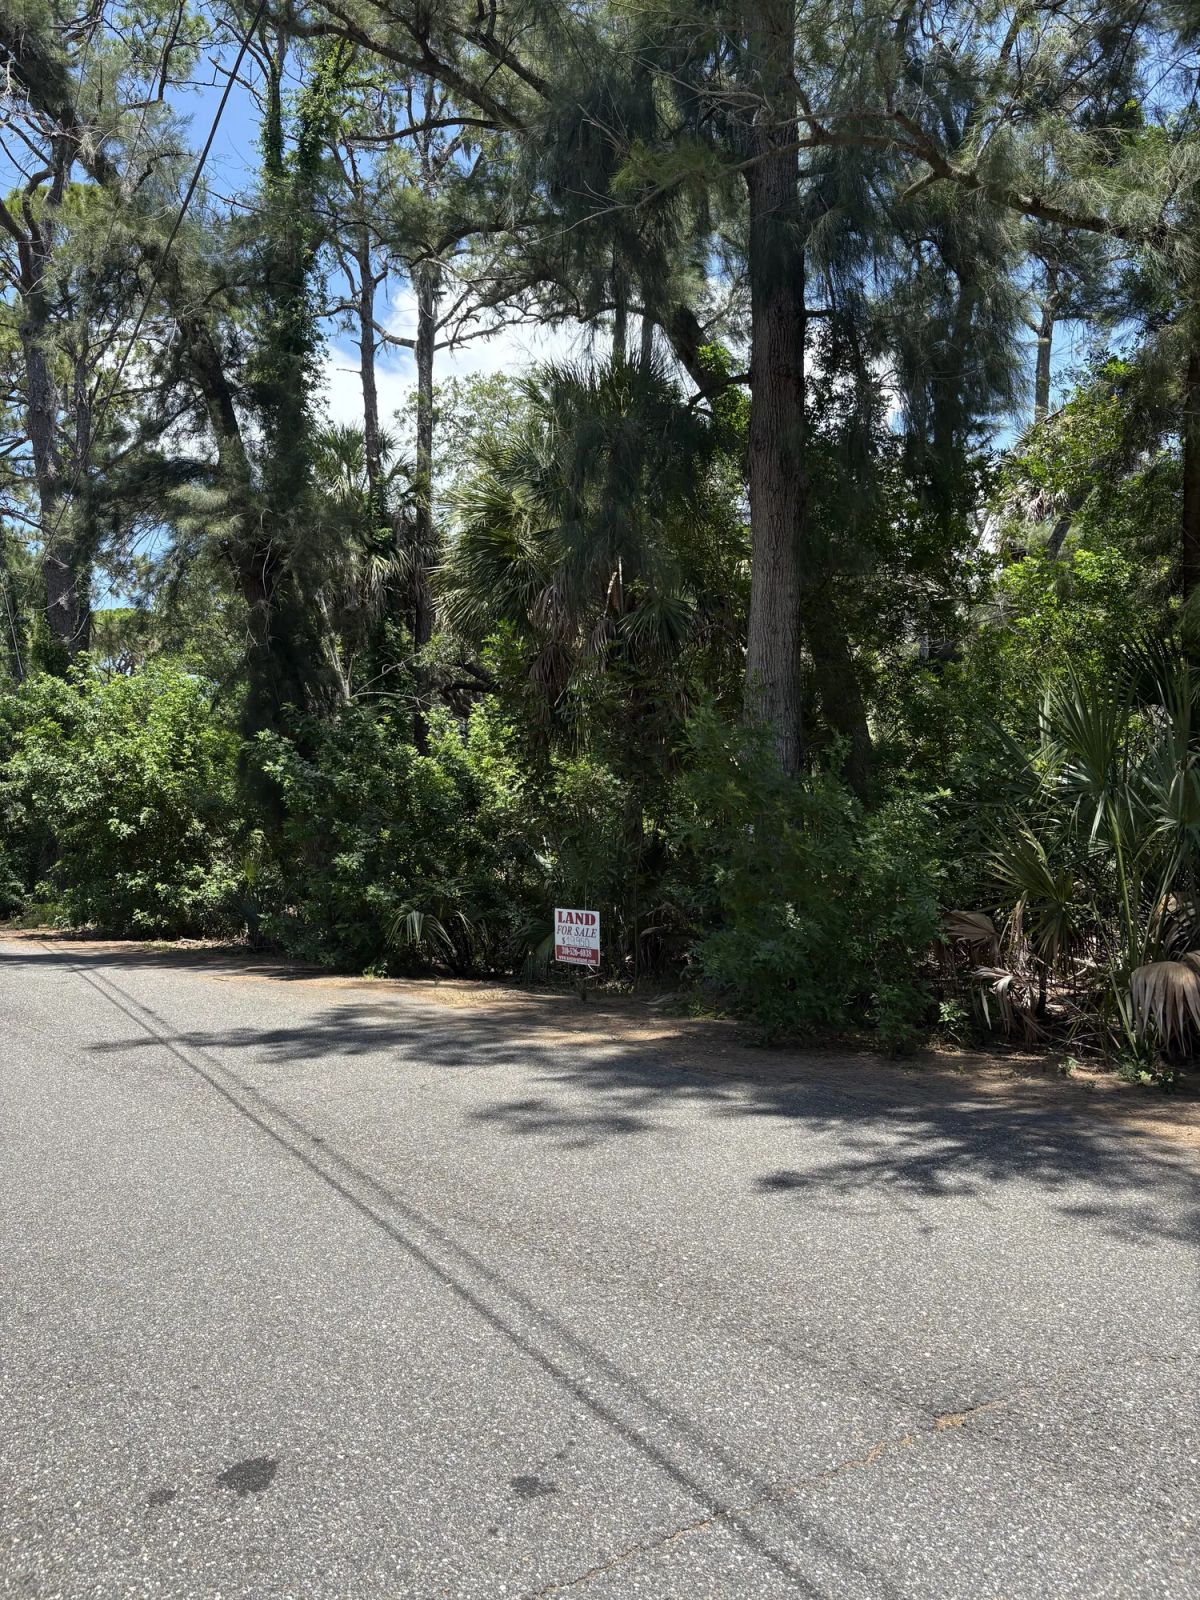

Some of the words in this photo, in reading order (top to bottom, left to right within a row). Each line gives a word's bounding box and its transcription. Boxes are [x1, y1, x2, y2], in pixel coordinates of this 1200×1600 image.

[558, 911, 596, 926] LAND
[557, 925, 573, 936] FOR
[574, 927, 597, 939] SALE
